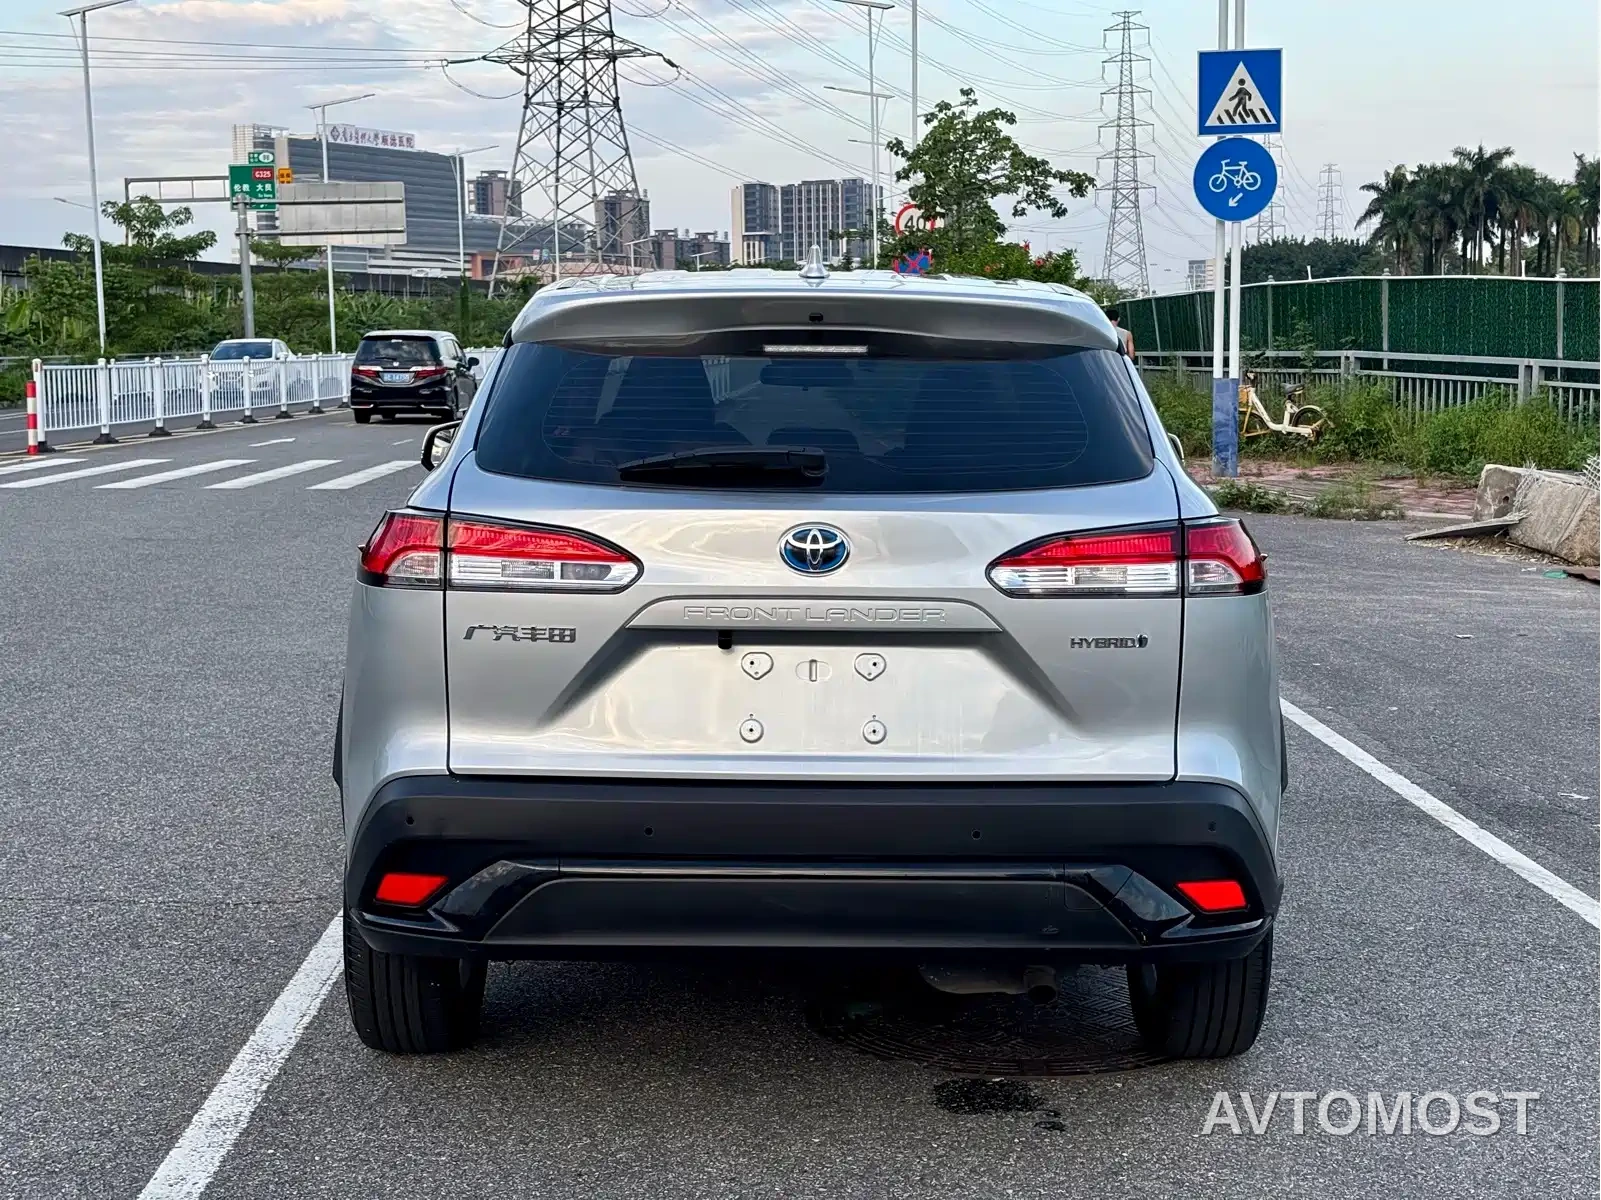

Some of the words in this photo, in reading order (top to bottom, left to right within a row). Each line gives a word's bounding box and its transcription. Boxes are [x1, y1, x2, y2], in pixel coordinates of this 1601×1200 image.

[254, 170, 272, 178] G325
[256, 183, 273, 192] 大良
[904, 214, 926, 231] 40
[463, 624, 577, 643] 广汽丰田
[1070, 637, 1138, 649] HYBRID
